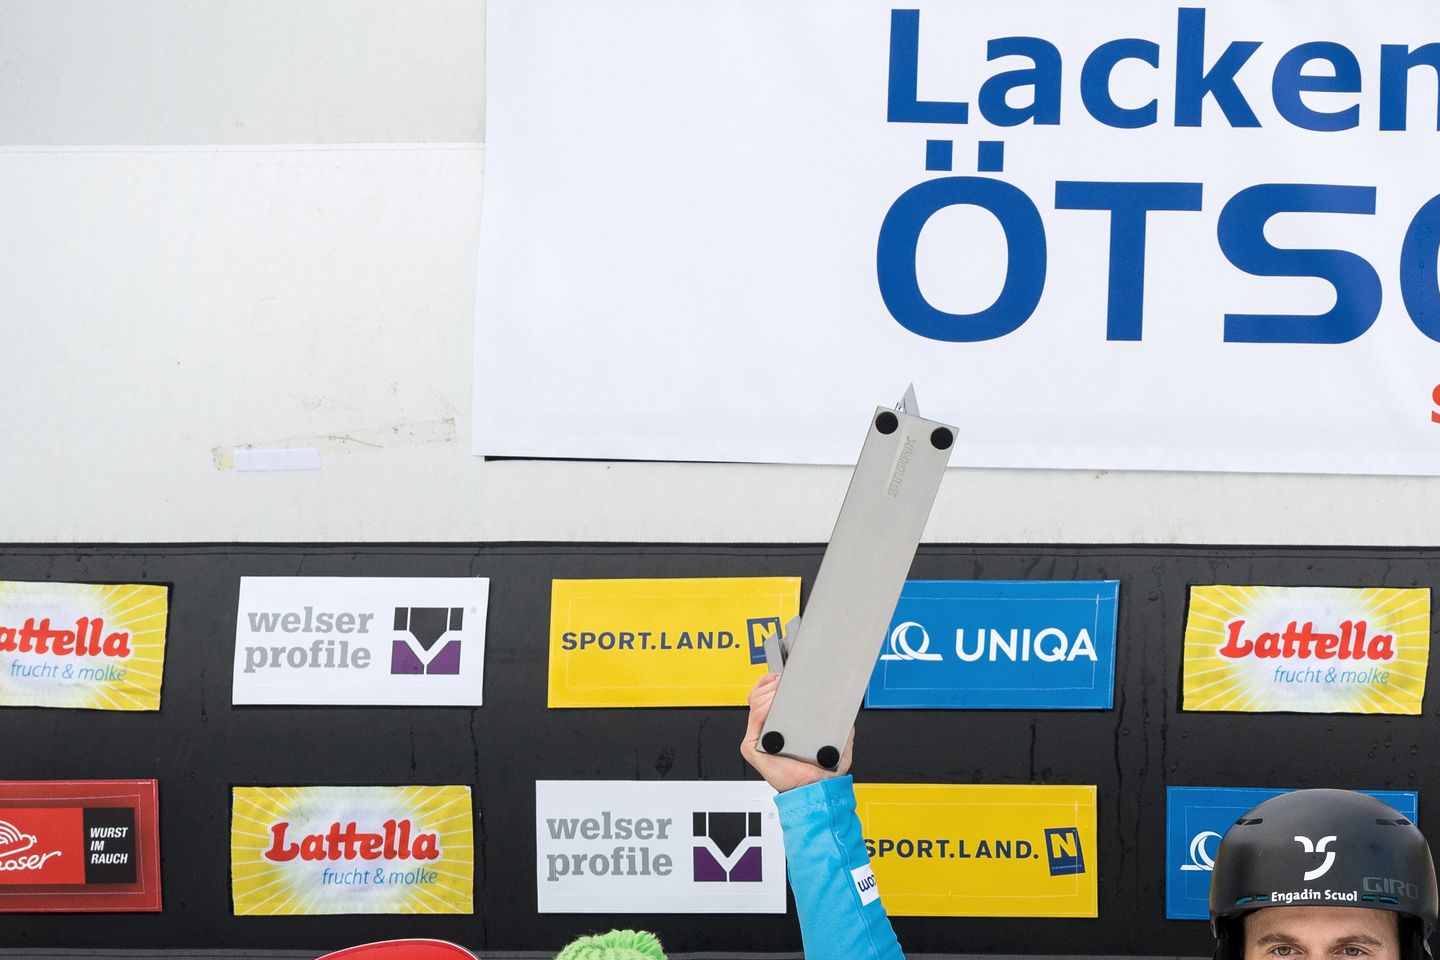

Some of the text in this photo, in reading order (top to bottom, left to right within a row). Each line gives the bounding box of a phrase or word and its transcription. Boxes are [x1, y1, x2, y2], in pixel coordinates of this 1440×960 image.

[247, 607, 374, 634] welser
[0, 616, 132, 658] attella
[561, 631, 741, 651] SPORT.LAND.
[954, 627, 1099, 664] UNIQA
[1218, 618, 1398, 661] Lattella
[243, 642, 372, 673] profile
[11, 659, 128, 682] frucht & molke
[1273, 665, 1391, 685] frucht & molke
[90, 827, 128, 838] WURST
[547, 812, 673, 840] welser
[90, 840, 105, 851] IM
[261, 821, 441, 863] Lattella
[91, 853, 128, 864] RAUCH
[546, 847, 673, 881] profile
[321, 866, 438, 887] frucht & molke
[1362, 876, 1418, 899] GIRO
[1271, 888, 1358, 904] Engadin Scuol
